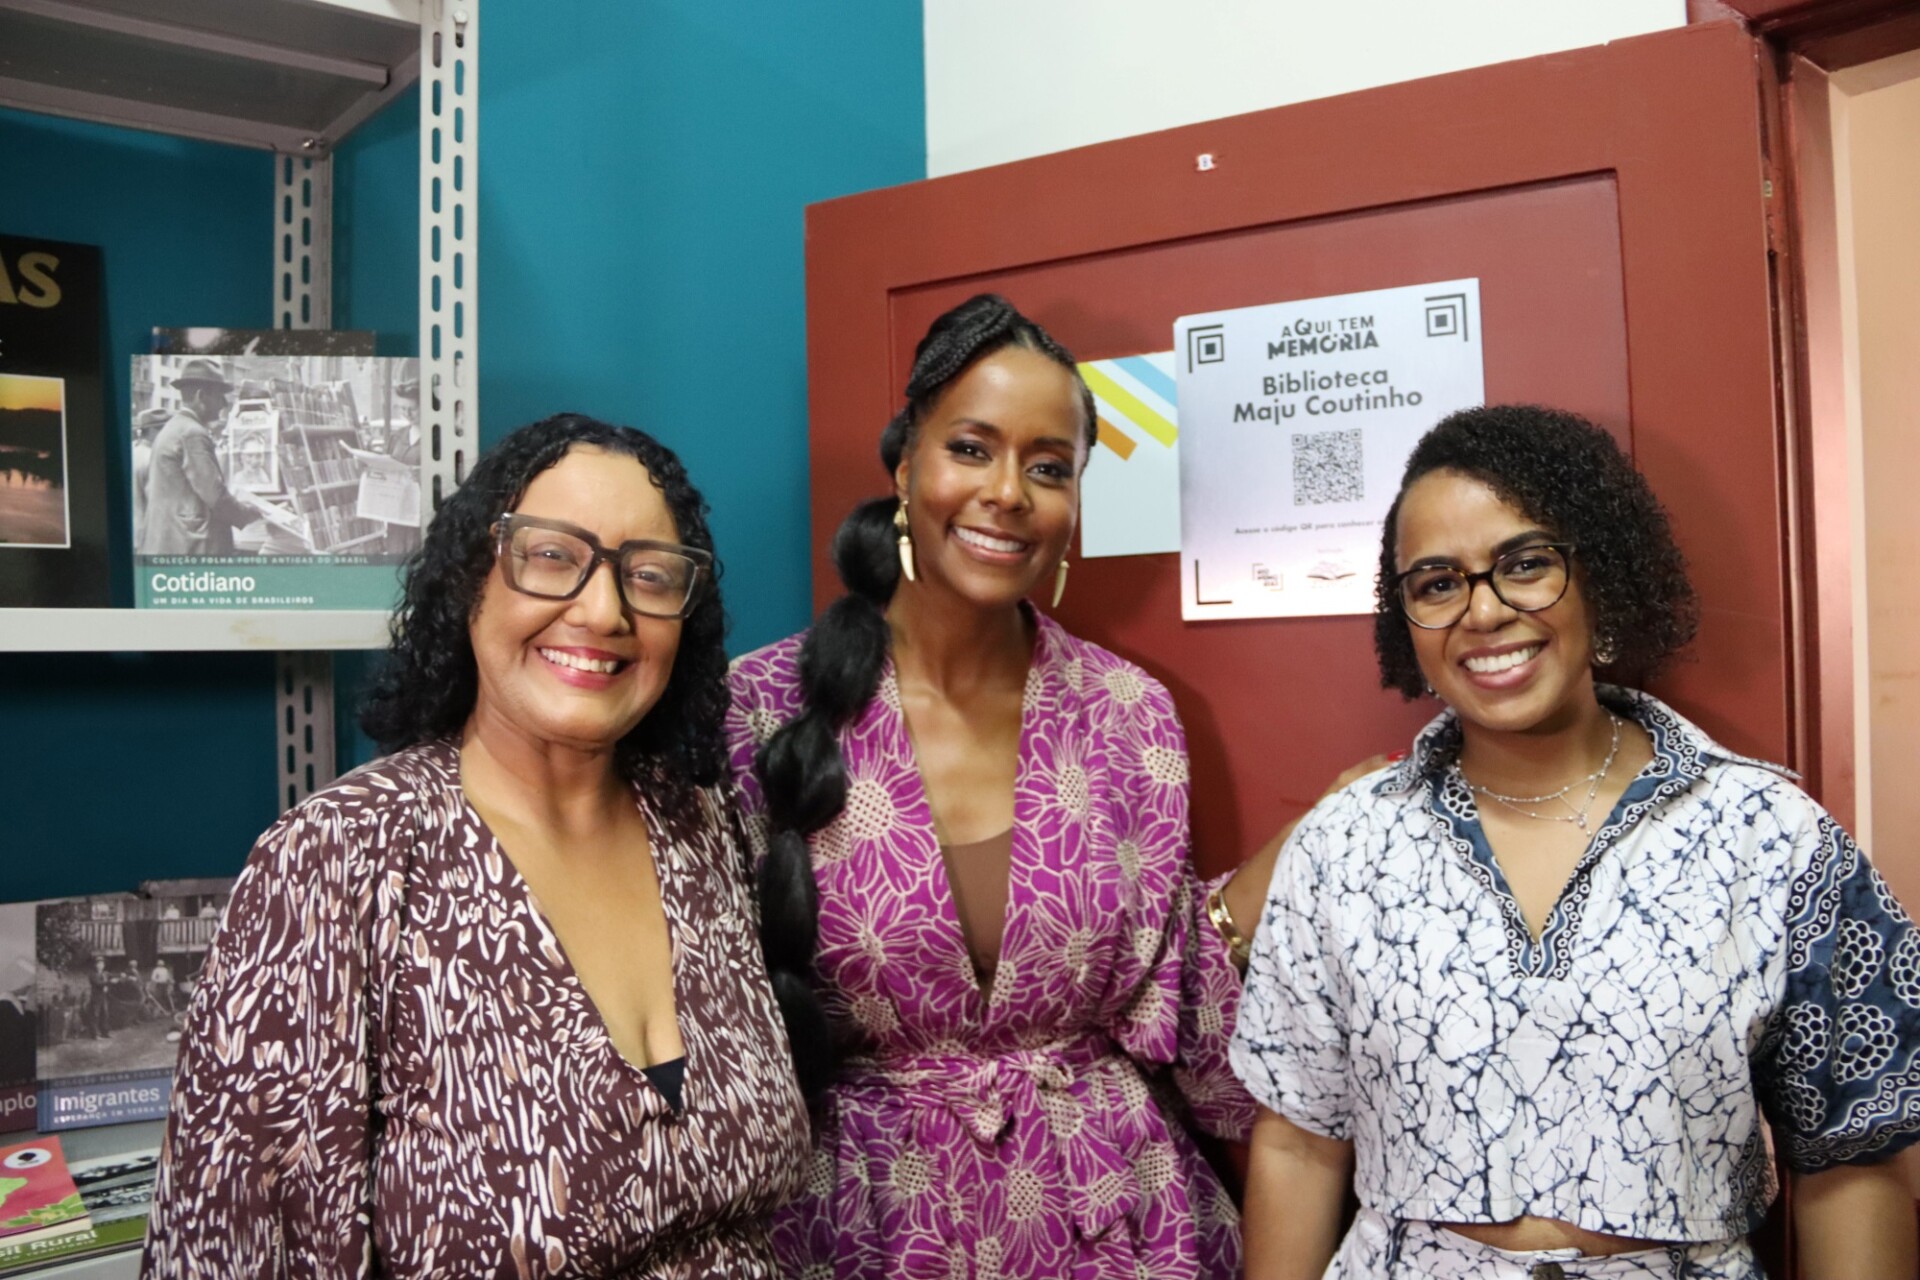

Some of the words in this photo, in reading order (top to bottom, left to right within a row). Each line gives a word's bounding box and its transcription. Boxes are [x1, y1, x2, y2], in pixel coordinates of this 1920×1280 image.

[1281, 318, 1331, 338] AQUI
[1338, 315, 1374, 331] TEM
[1263, 370, 1388, 396] Biblioteca
[1233, 399, 1296, 425] Maju
[1305, 386, 1423, 415] Coutinho
[1300, 522, 1313, 531] QR
[152, 556, 198, 565] COLEÇÃO
[201, 556, 234, 564] FOLHA
[238, 556, 268, 564] FOTOS
[272, 556, 314, 564] ANTIGAS
[317, 556, 332, 564] DO
[335, 556, 368, 564] BRASIL
[152, 571, 256, 593] Cotidiano
[153, 597, 167, 605] UM
[171, 597, 188, 605] DIA
[191, 597, 206, 605] NA
[209, 597, 232, 605] VIDA
[235, 597, 248, 605] DE
[251, 596, 314, 605] BRASILEIROS
[54, 1087, 161, 1113] Imigrantes
[30, 1230, 98, 1251] Rural
